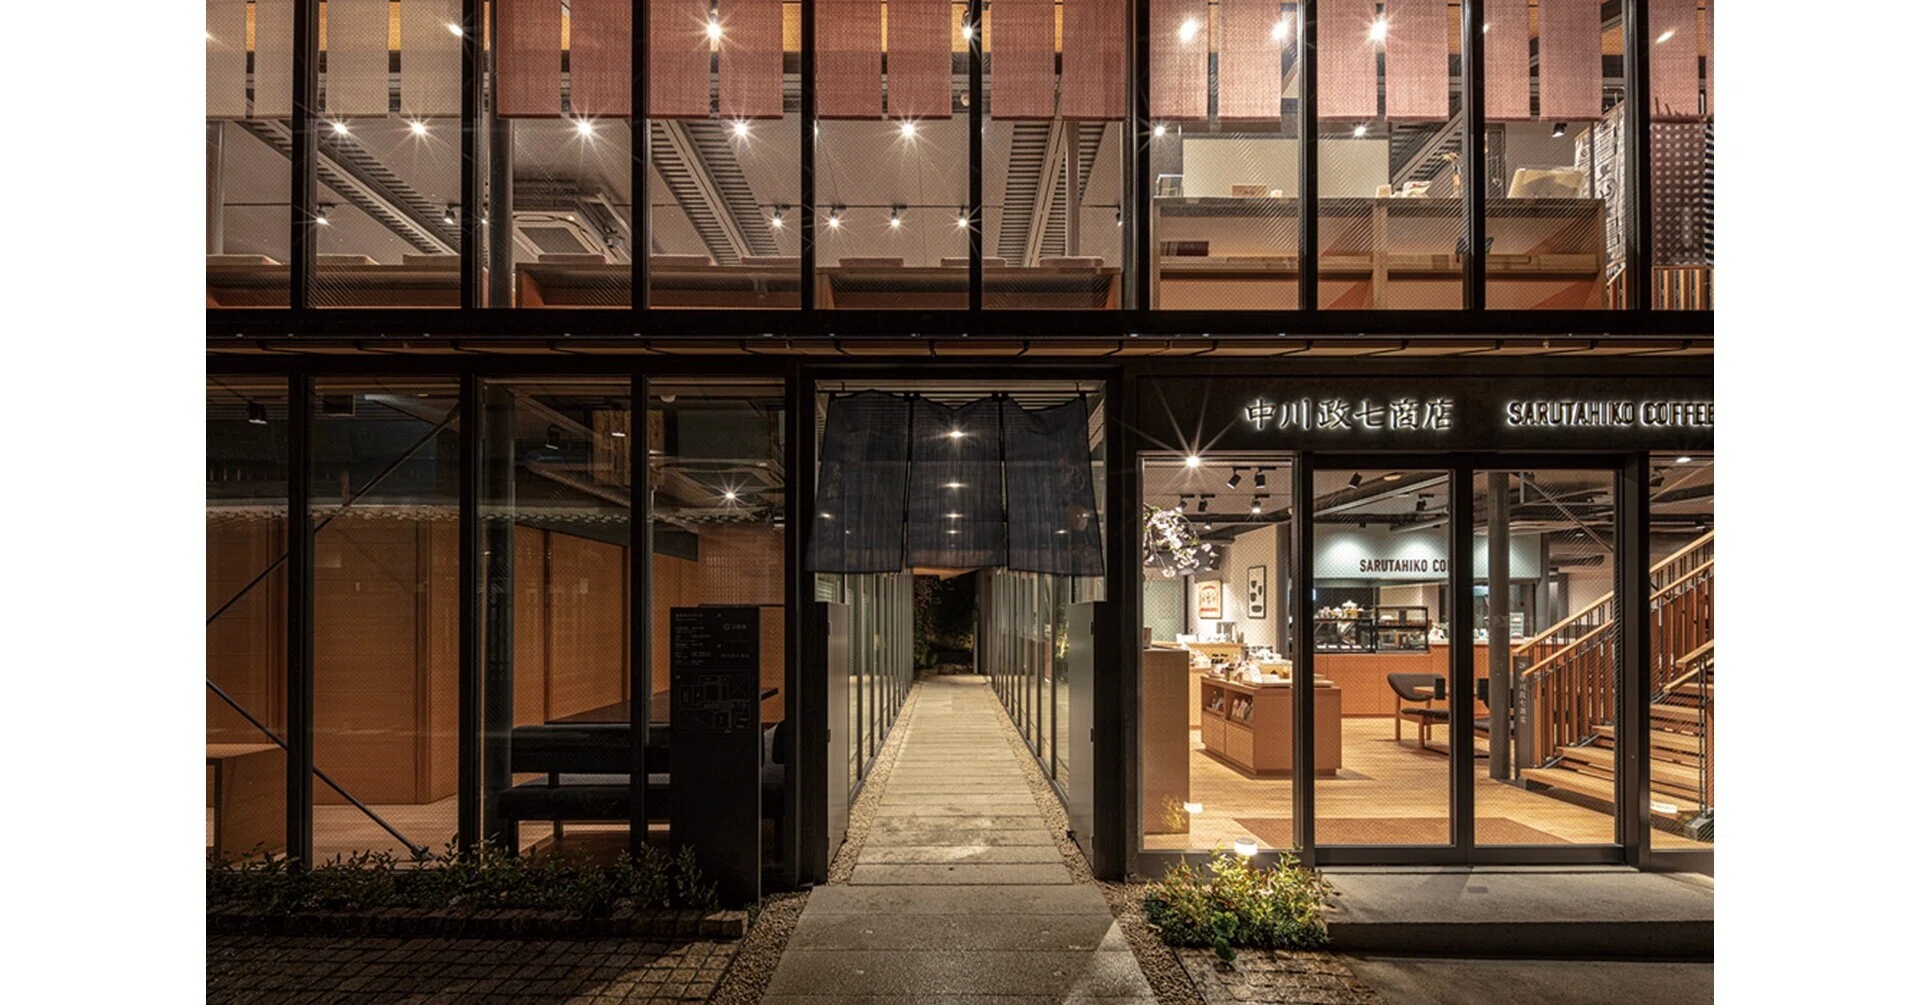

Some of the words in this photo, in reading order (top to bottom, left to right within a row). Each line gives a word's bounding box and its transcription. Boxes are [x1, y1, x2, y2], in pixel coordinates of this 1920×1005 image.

[1244, 398, 1453, 430] 中川政七商店
[1507, 401, 1636, 426] SARUTAHIKO
[1360, 559, 1428, 572] SARUTAHIKO
